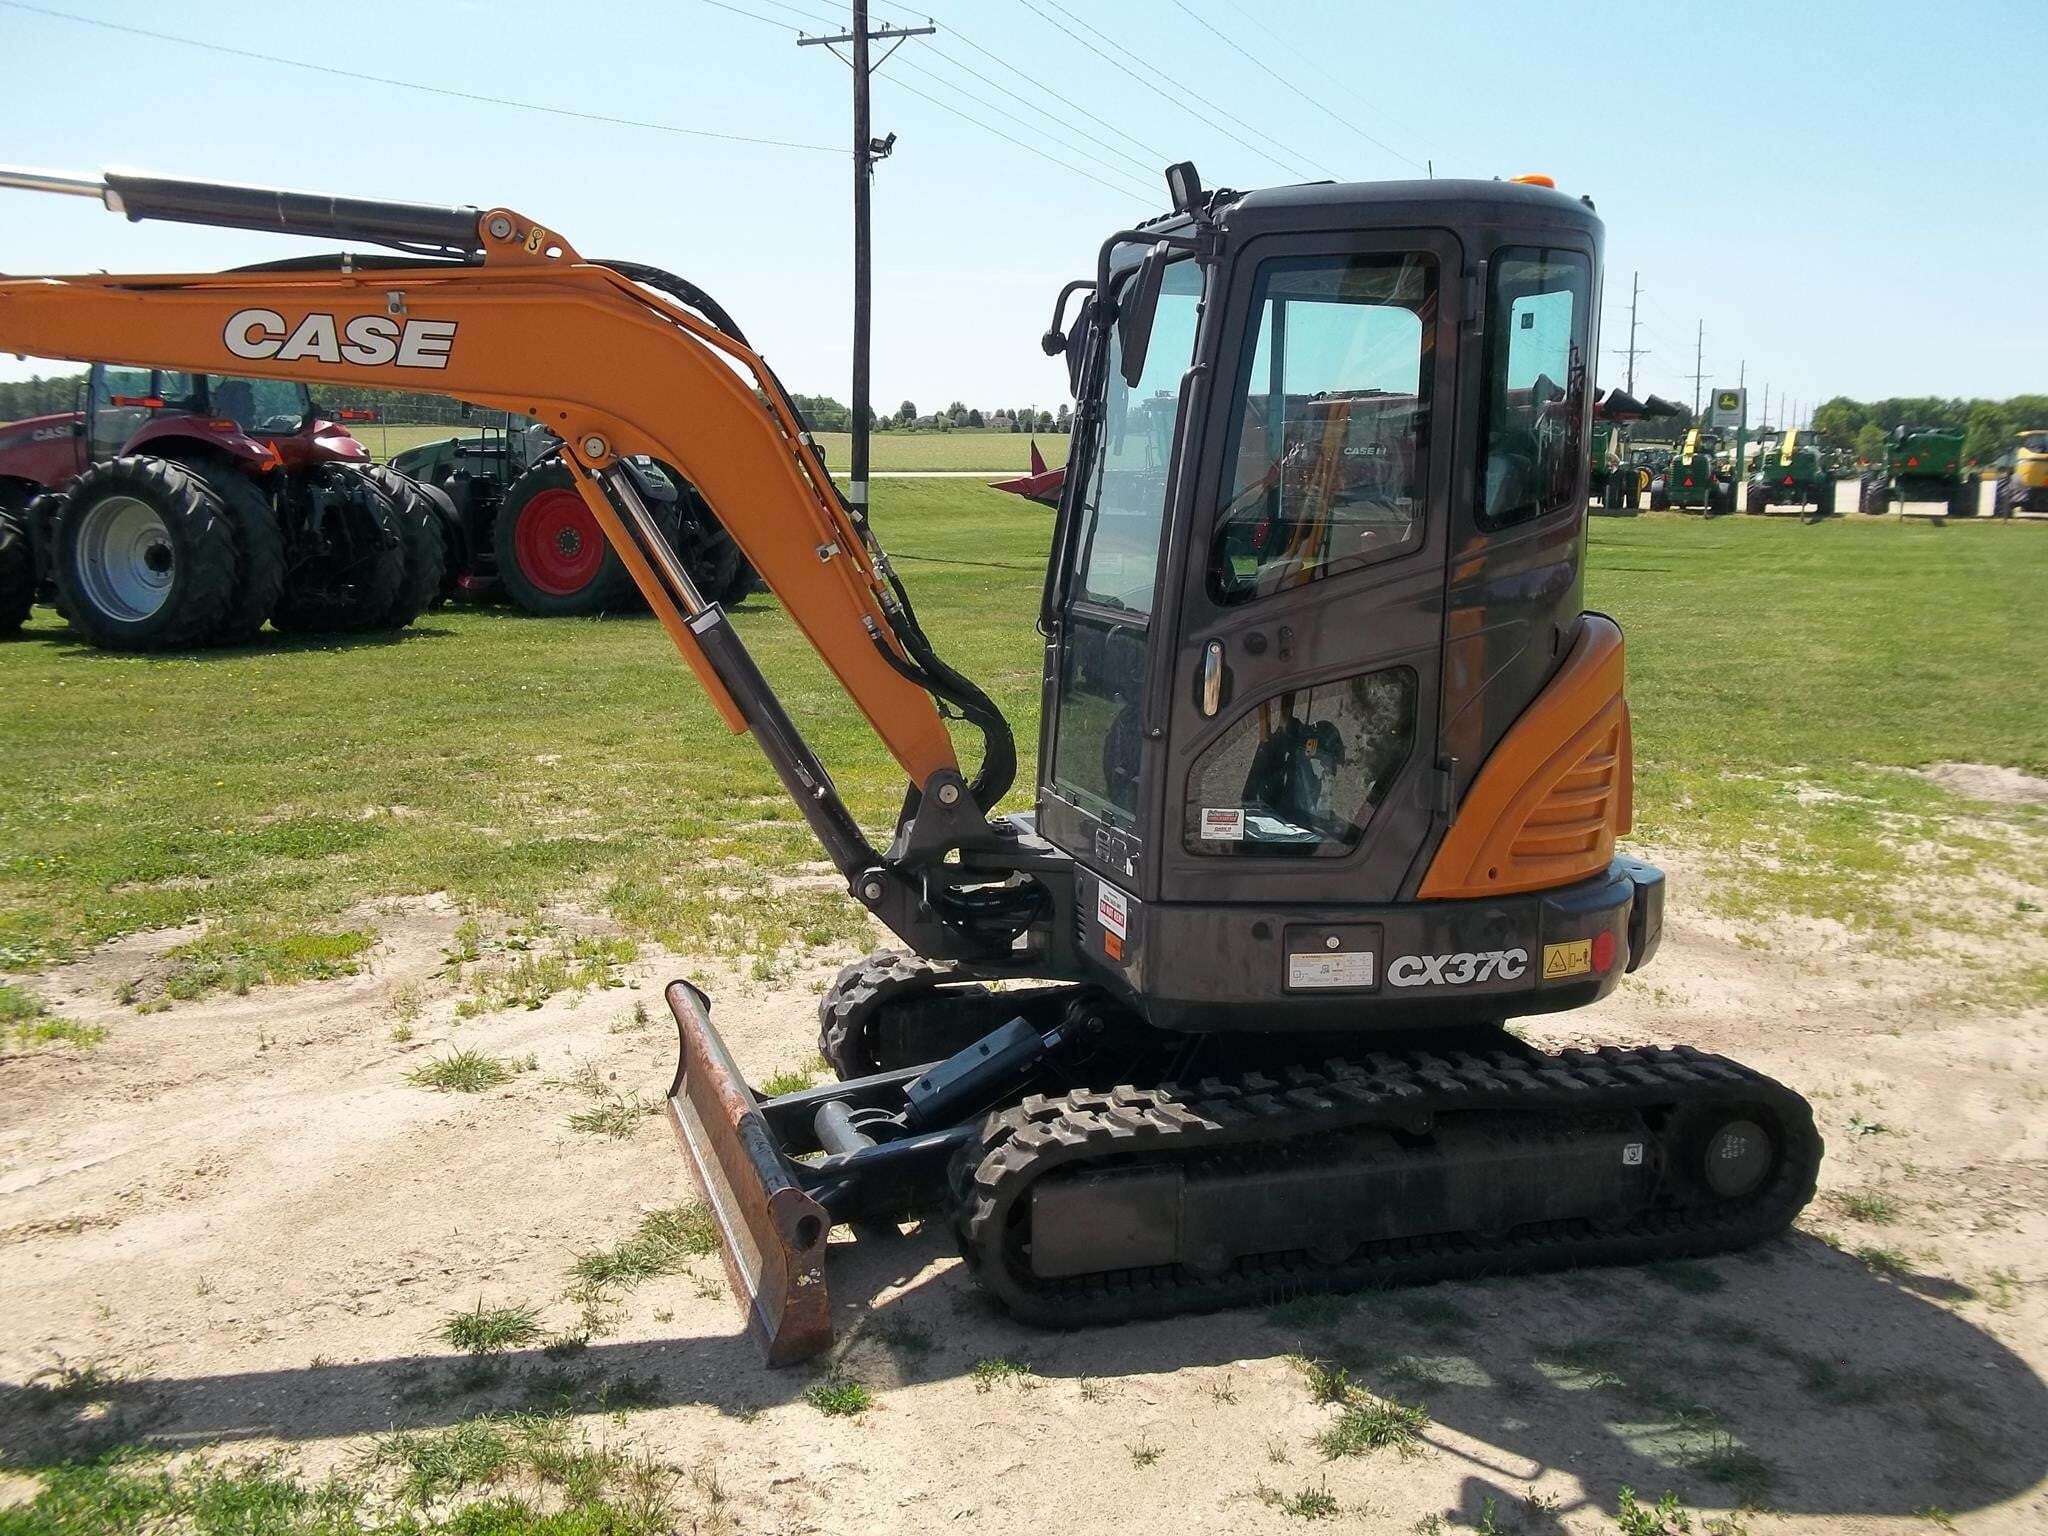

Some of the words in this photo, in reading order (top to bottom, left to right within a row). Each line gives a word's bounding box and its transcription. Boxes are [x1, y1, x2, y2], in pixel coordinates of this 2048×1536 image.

[223, 308, 459, 369] CASE
[1343, 447, 1375, 455] CASE
[1106, 905, 1114, 919] NOT
[1113, 910, 1124, 927] RENT
[1387, 948, 1528, 987] CX37C
